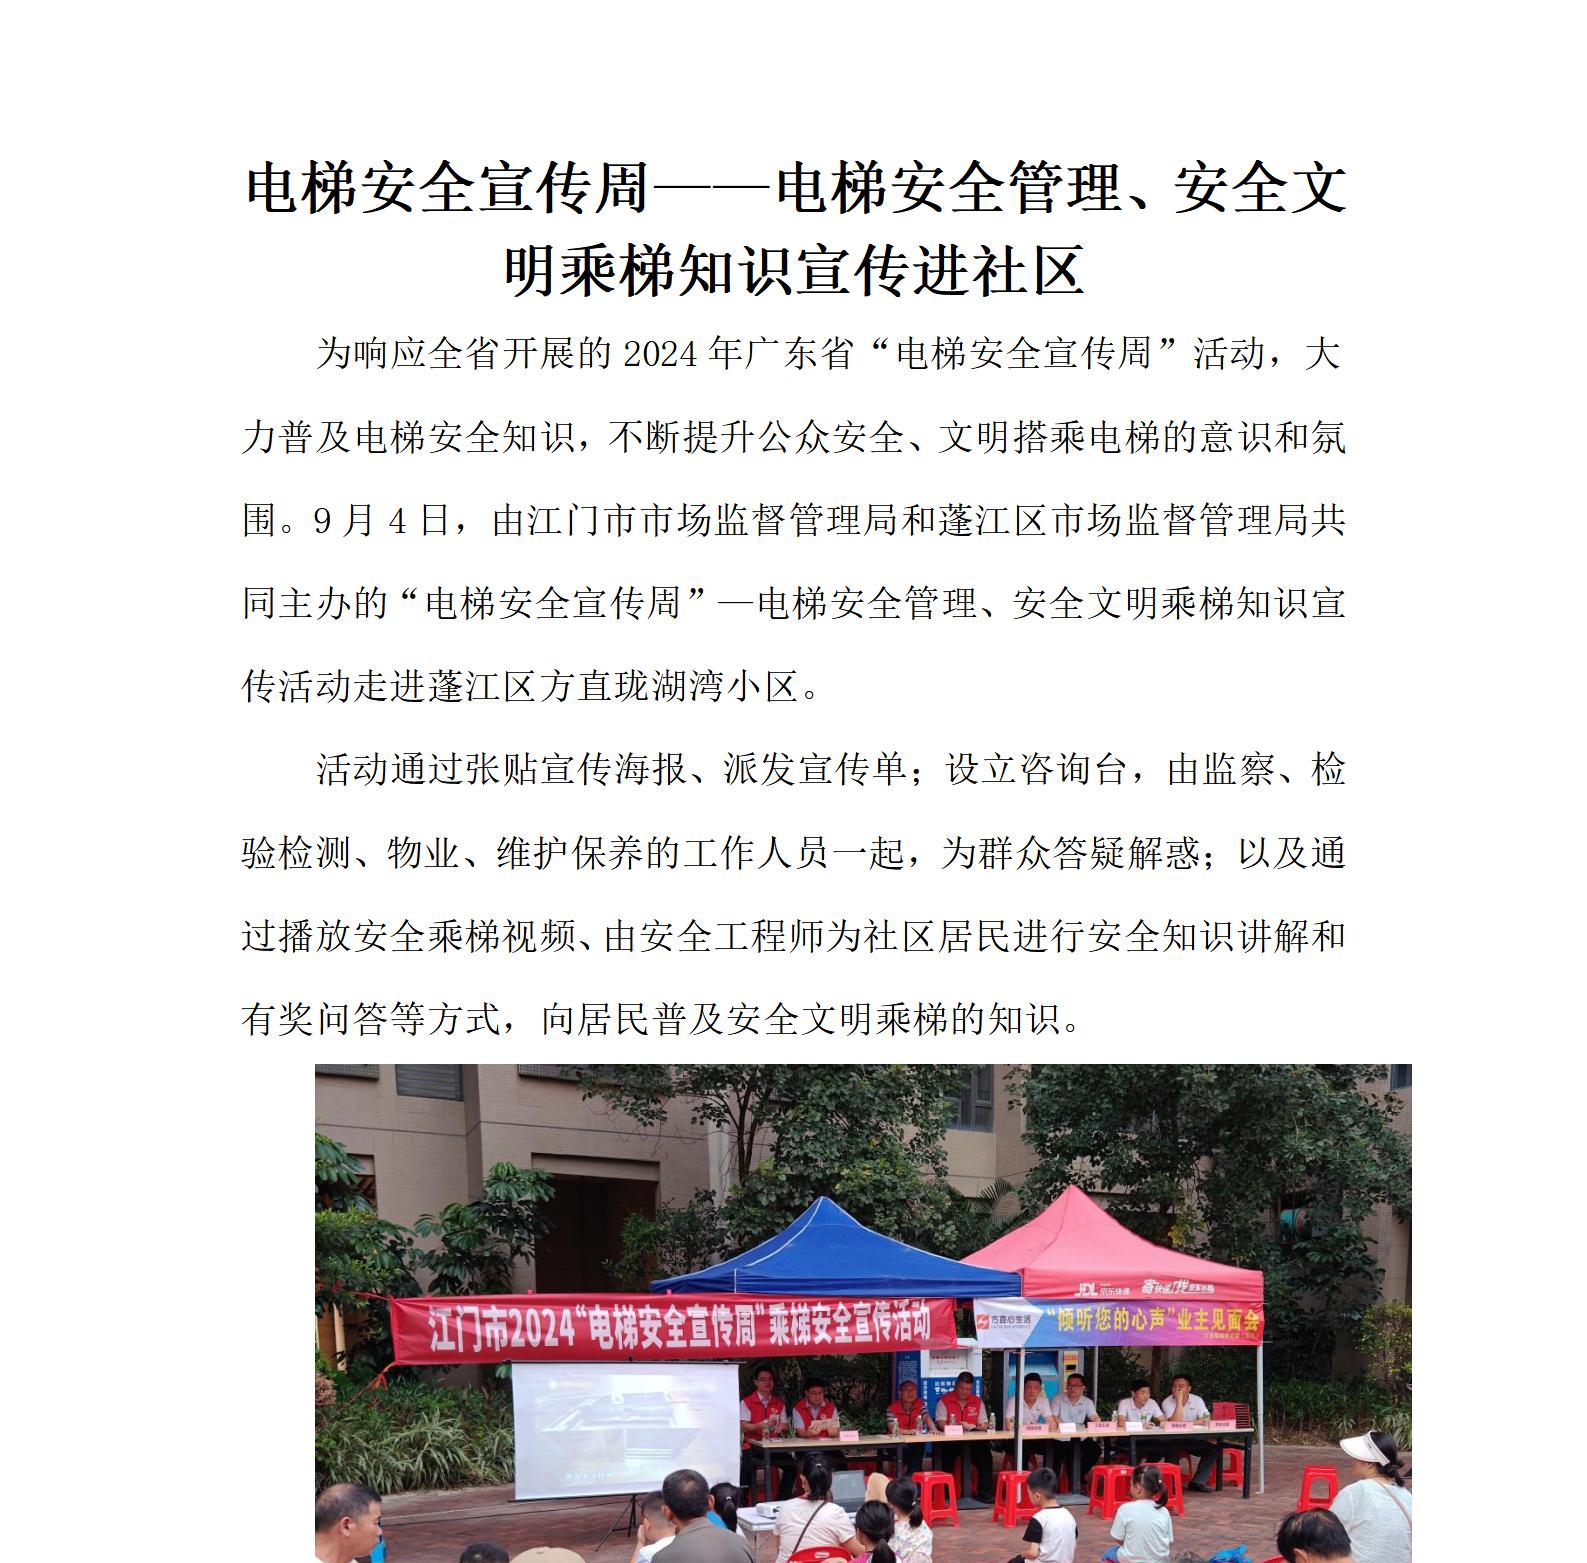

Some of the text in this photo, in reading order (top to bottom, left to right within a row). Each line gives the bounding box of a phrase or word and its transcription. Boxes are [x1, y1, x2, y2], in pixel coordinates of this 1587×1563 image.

[248, 159, 1347, 215] 电梯安全宣传周——电梯安全管理、安全文
[506, 242, 1085, 298] 明乘梯知识宣传进社区
[241, 418, 1346, 455] 力普及电梯安全知识，不断提升公众安全、文明搭乘电梯的意识和氛
[240, 668, 814, 704] 传活动走进蓬江区方直珑湖湾小区。
[316, 750, 1346, 787] 活动通过张贴宣传海报、派发宣传单；设立咨询台，由监察、检
[241, 834, 1346, 871] 验检测、物业、维护保养的工作人员一起，为群众答疑解惑；以及通
[241, 918, 1345, 954] 过播放安全乘梯视频、由安全工程师为社区居民进行安全知识讲解和
[241, 1000, 1075, 1037] 有奖问答等方式，向居民普及安全文明乘梯的知识。
[1074, 1282, 1099, 1297] JDL
[428, 1299, 931, 1353] 江门市2024“电梯安全宣传周”乘梯安全宣传活动
[1047, 1305, 1259, 1333] “倾听您的心声”业主见面会
